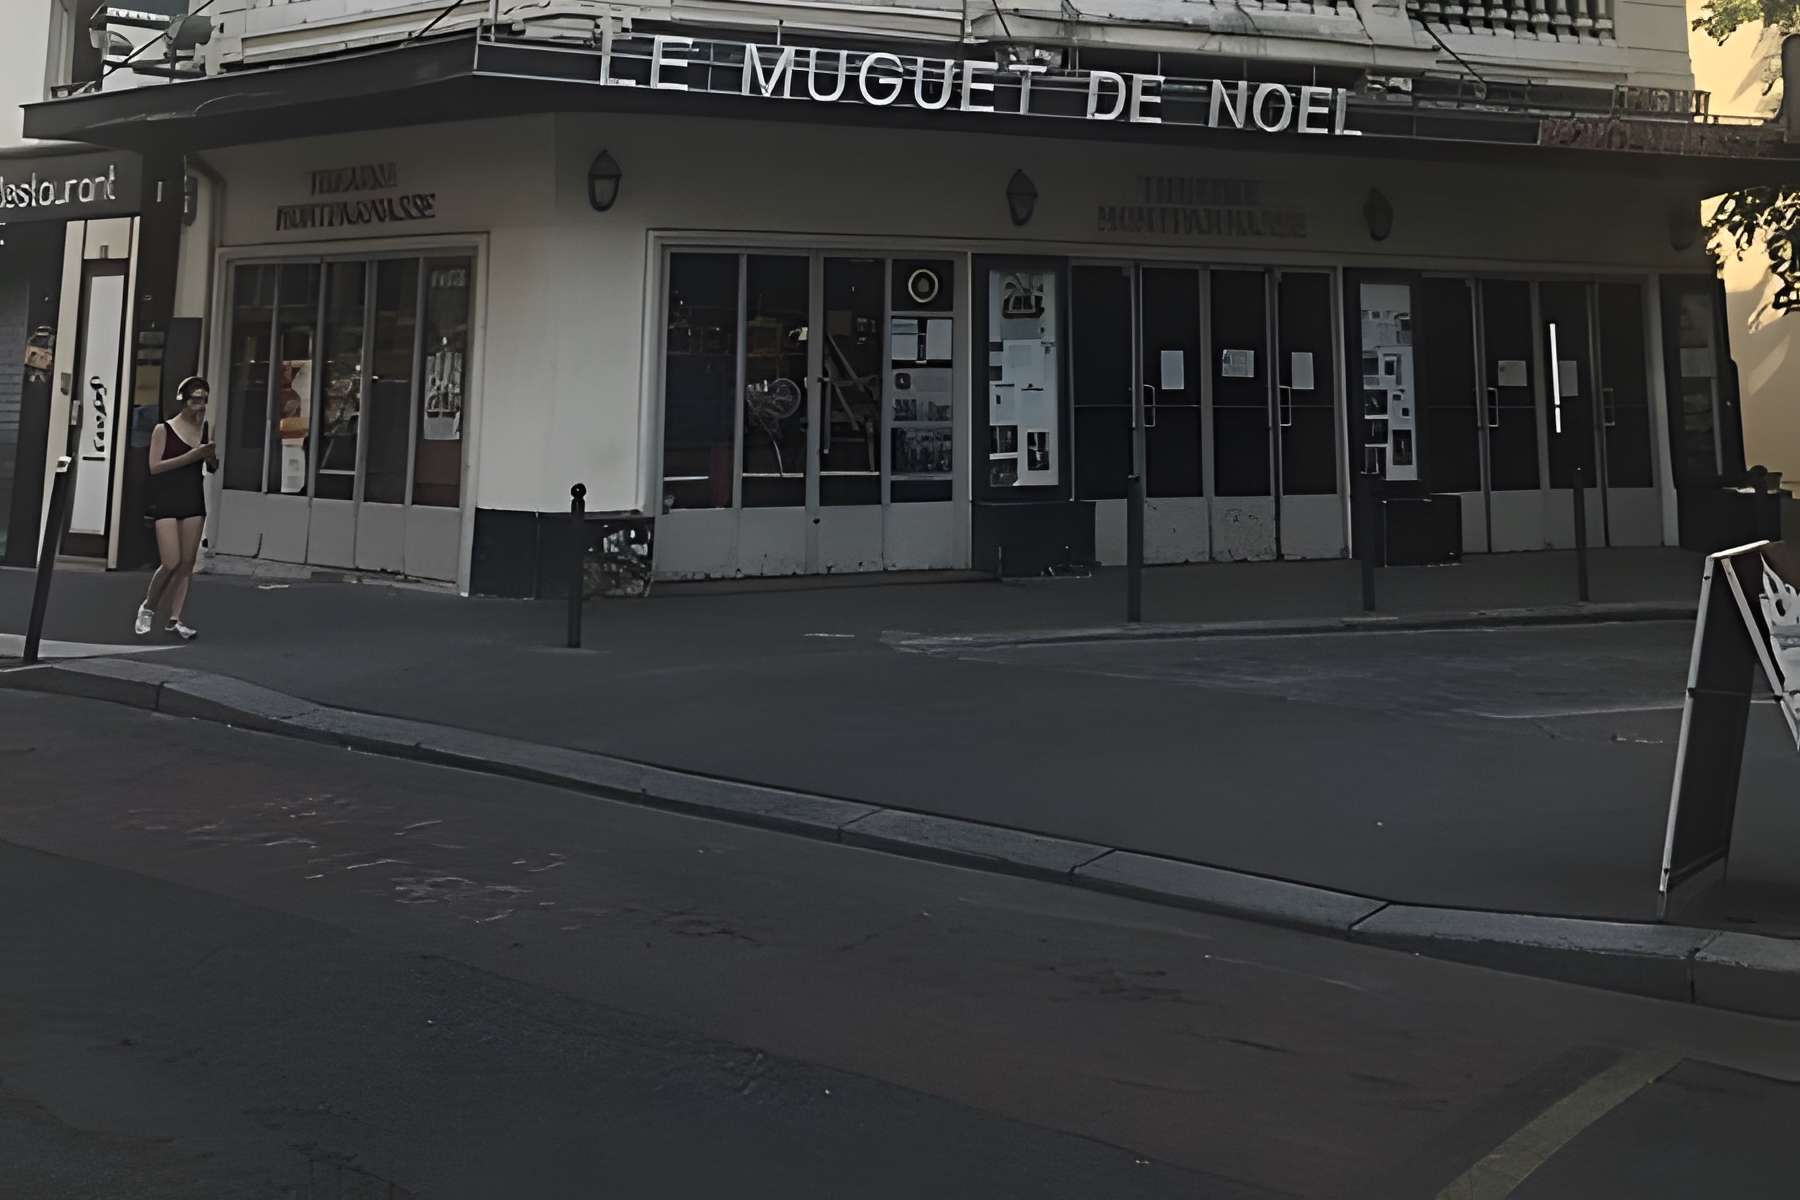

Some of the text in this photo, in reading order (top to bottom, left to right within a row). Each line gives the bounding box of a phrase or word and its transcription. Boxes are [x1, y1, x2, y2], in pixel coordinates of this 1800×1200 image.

[600, 16, 1362, 136] LE MUGUET DE NOEL
